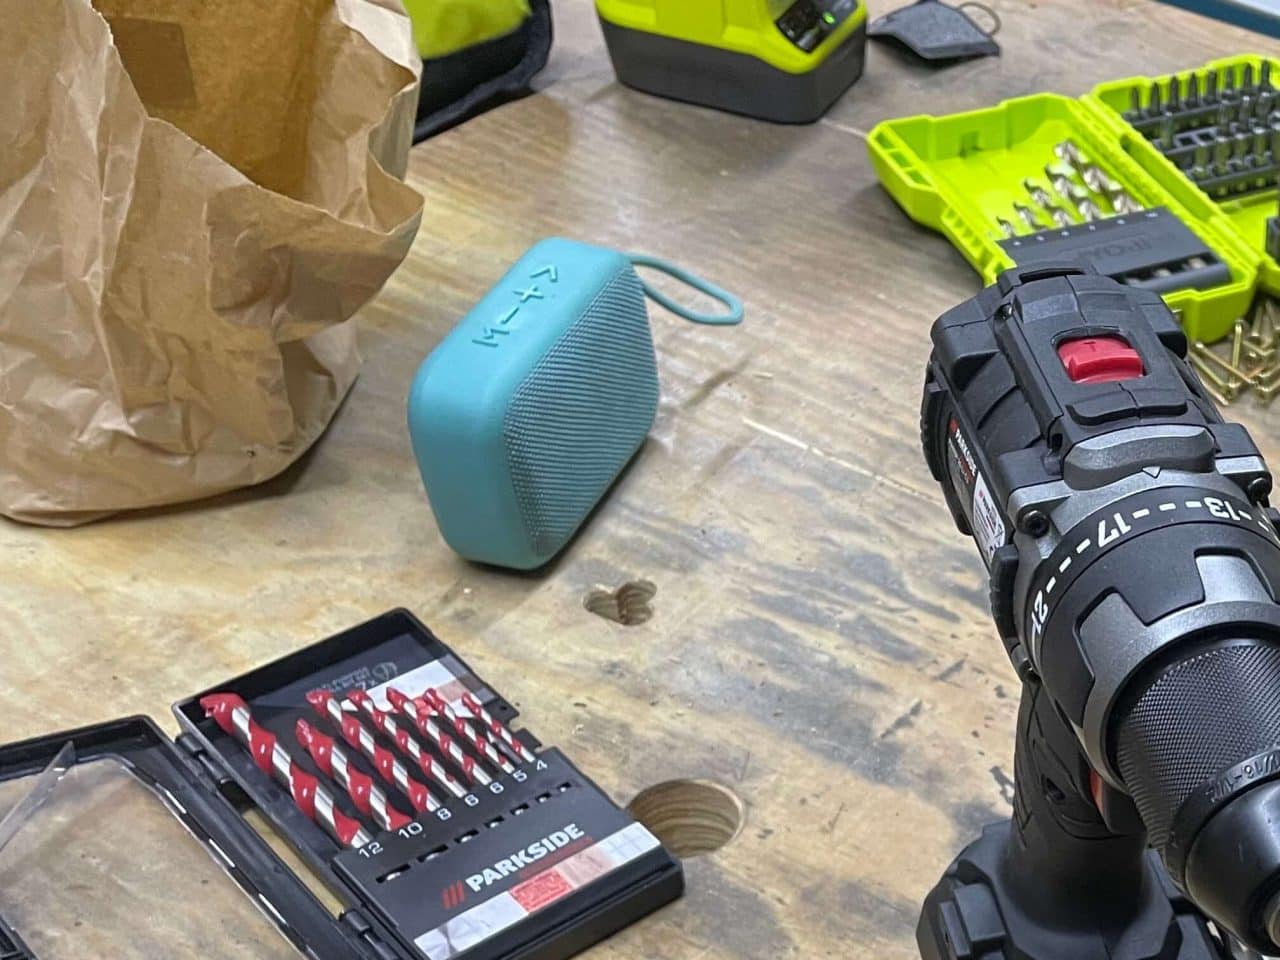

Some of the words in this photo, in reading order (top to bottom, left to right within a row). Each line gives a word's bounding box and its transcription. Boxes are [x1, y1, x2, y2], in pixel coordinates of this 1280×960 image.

[1098, 512, 1132, 548] 17
[1203, 496, 1241, 521] 13
[358, 841, 384, 859] 12
[398, 821, 423, 839] 10
[436, 807, 452, 821] 8
[513, 769, 528, 782] 5
[536, 759, 548, 771] 4
[465, 823, 585, 892] PARKSIDE
